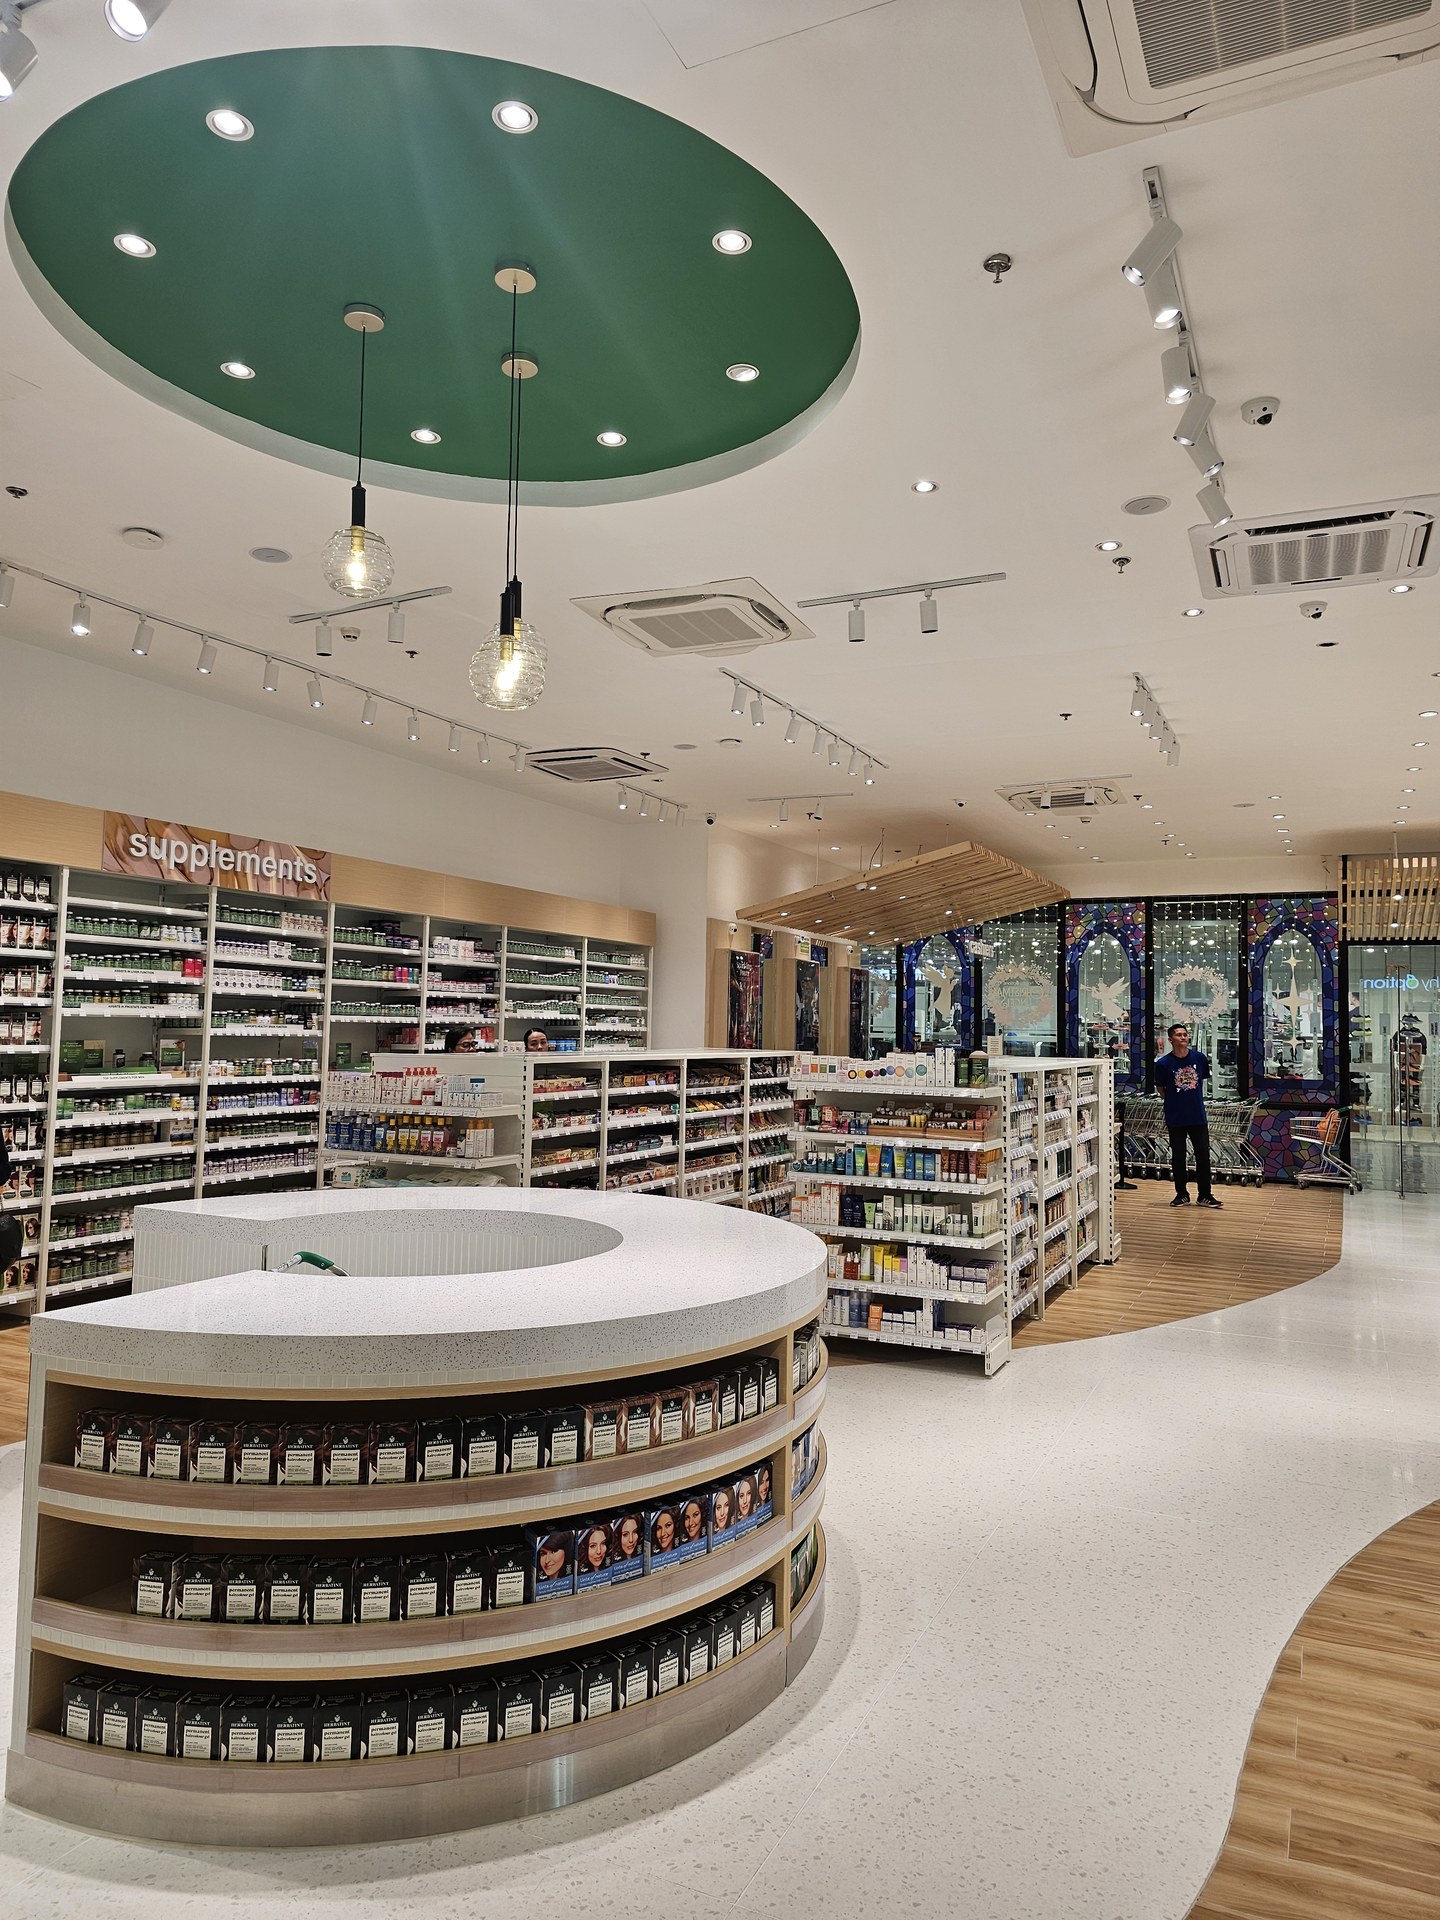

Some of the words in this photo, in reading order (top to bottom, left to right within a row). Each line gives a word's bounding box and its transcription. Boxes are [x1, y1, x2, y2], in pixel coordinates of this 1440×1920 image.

[129, 832, 318, 884] supplements
[550, 1688, 573, 1697] HERBATINT
[69, 1700, 88, 1708] HERBATINT
[506, 1698, 531, 1706] HERBATINT
[550, 1696, 572, 1705] permanent
[507, 1706, 531, 1715] permanent
[462, 1714, 487, 1722] permanent
[418, 1720, 443, 1728] permanent
